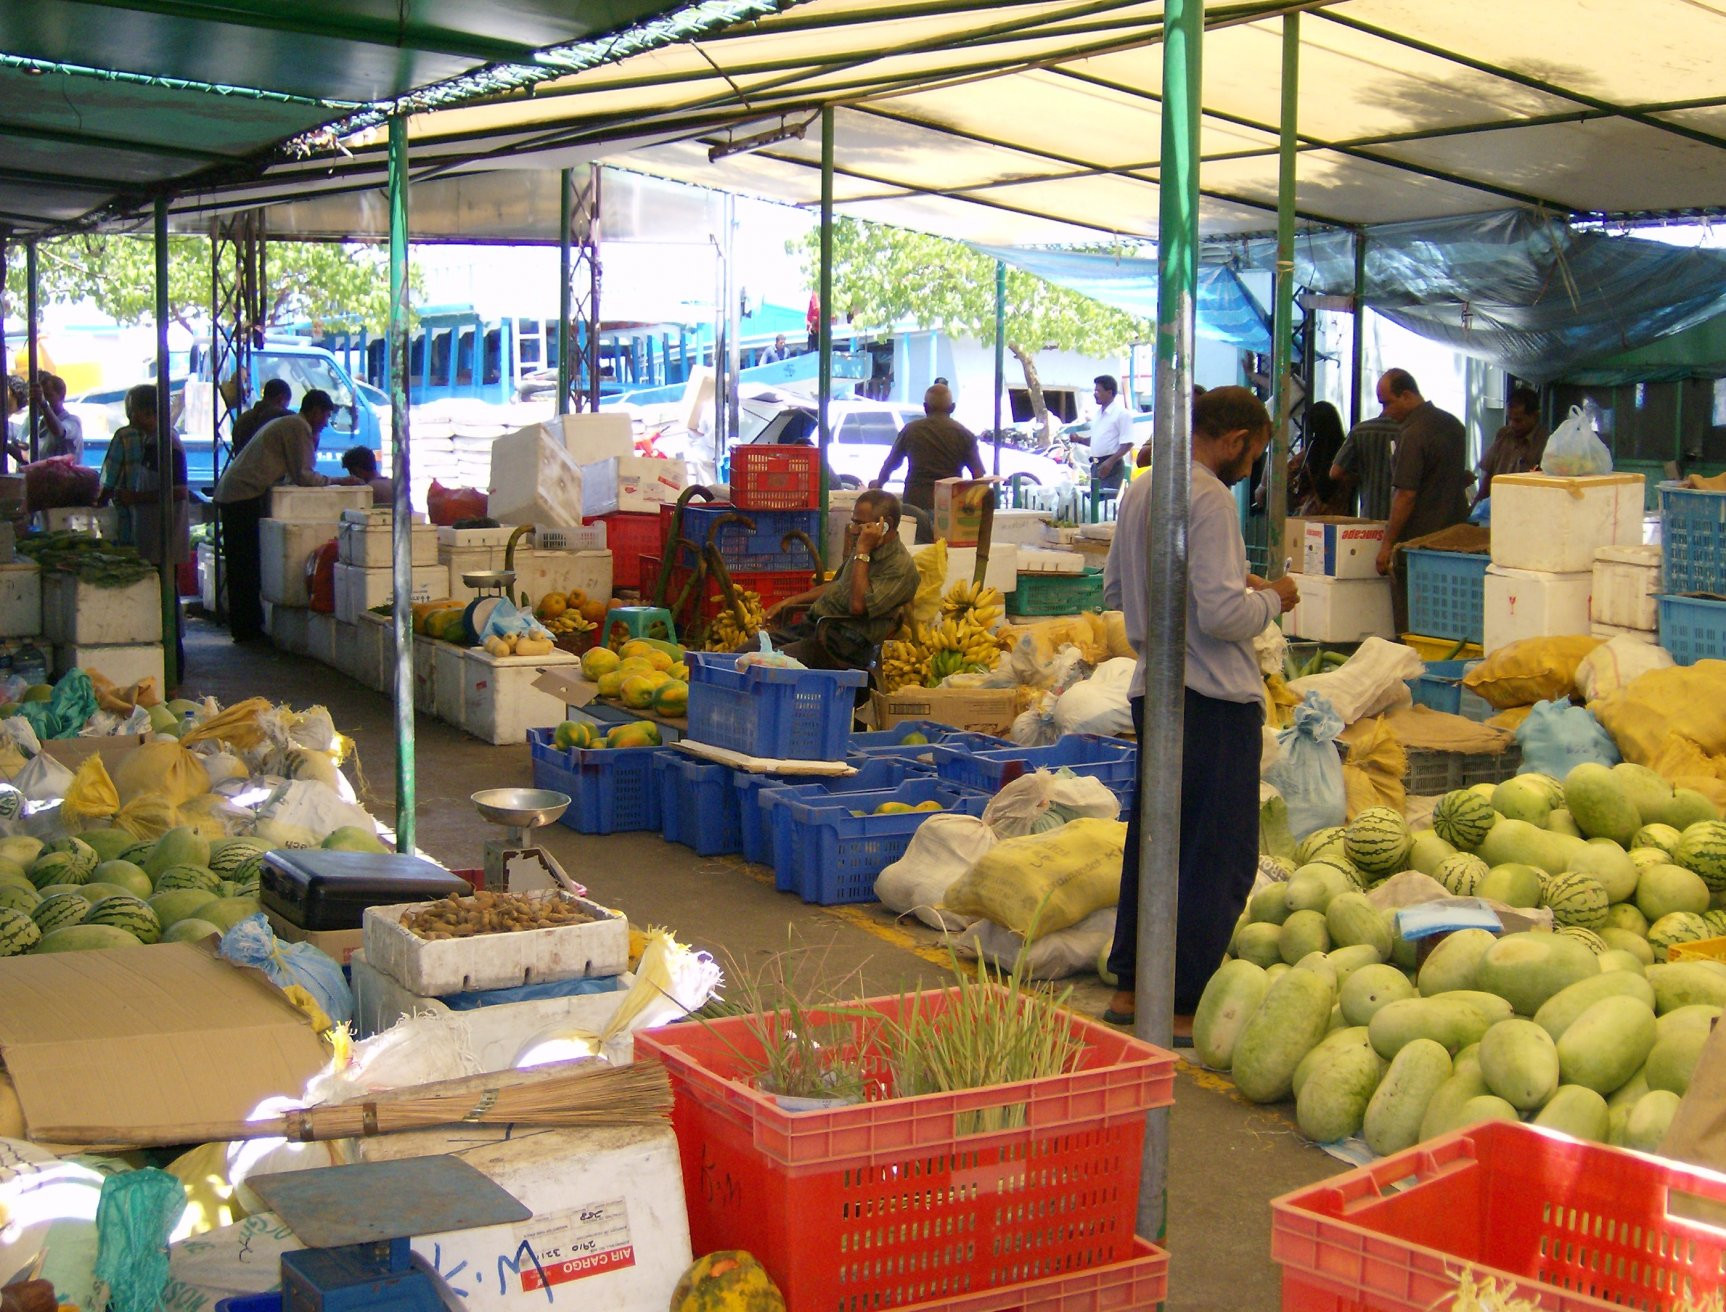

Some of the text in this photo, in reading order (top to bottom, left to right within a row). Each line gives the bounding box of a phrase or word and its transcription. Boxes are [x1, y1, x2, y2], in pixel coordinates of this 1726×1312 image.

[571, 1240, 596, 1252] 2910
[610, 1248, 632, 1262] AIR
[563, 1254, 609, 1273] CARGO
